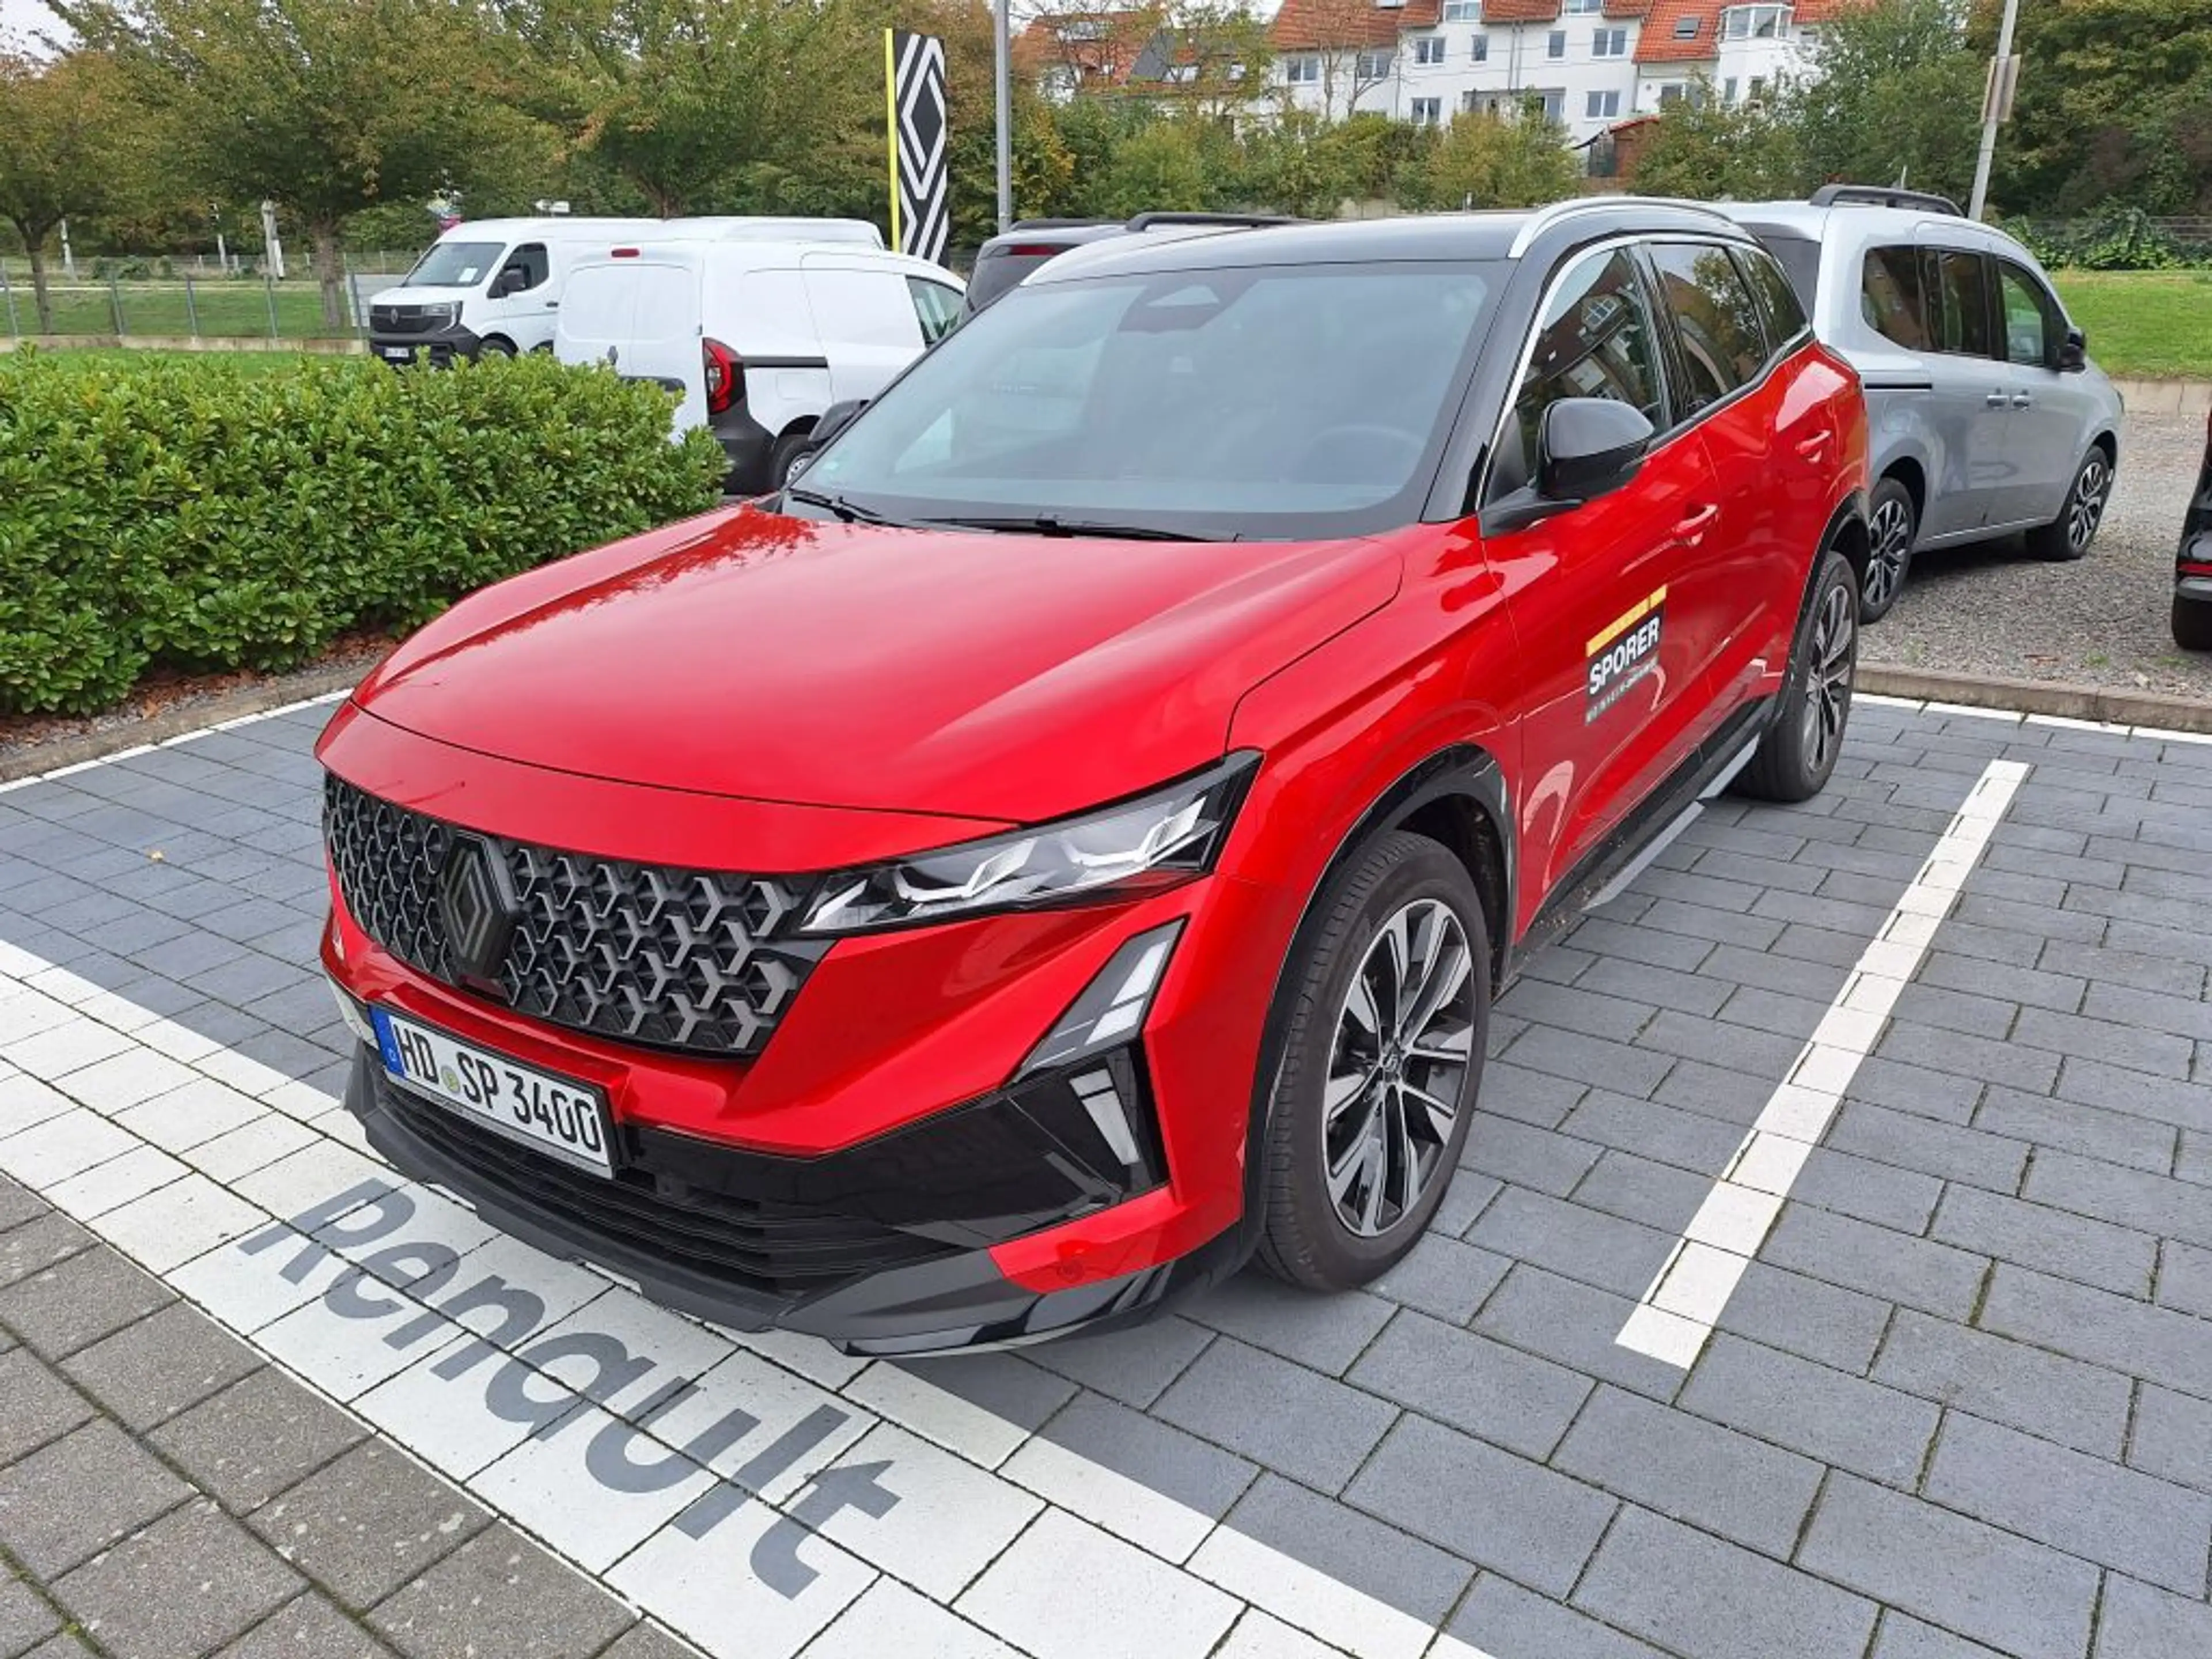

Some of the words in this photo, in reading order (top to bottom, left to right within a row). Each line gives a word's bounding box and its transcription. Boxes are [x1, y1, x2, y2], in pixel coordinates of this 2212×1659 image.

[1589, 616, 1660, 695] SPORER
[393, 1024, 439, 1084] HD
[456, 1051, 499, 1109] SP
[504, 1070, 601, 1152] 3400
[237, 1177, 903, 1601] Renault
